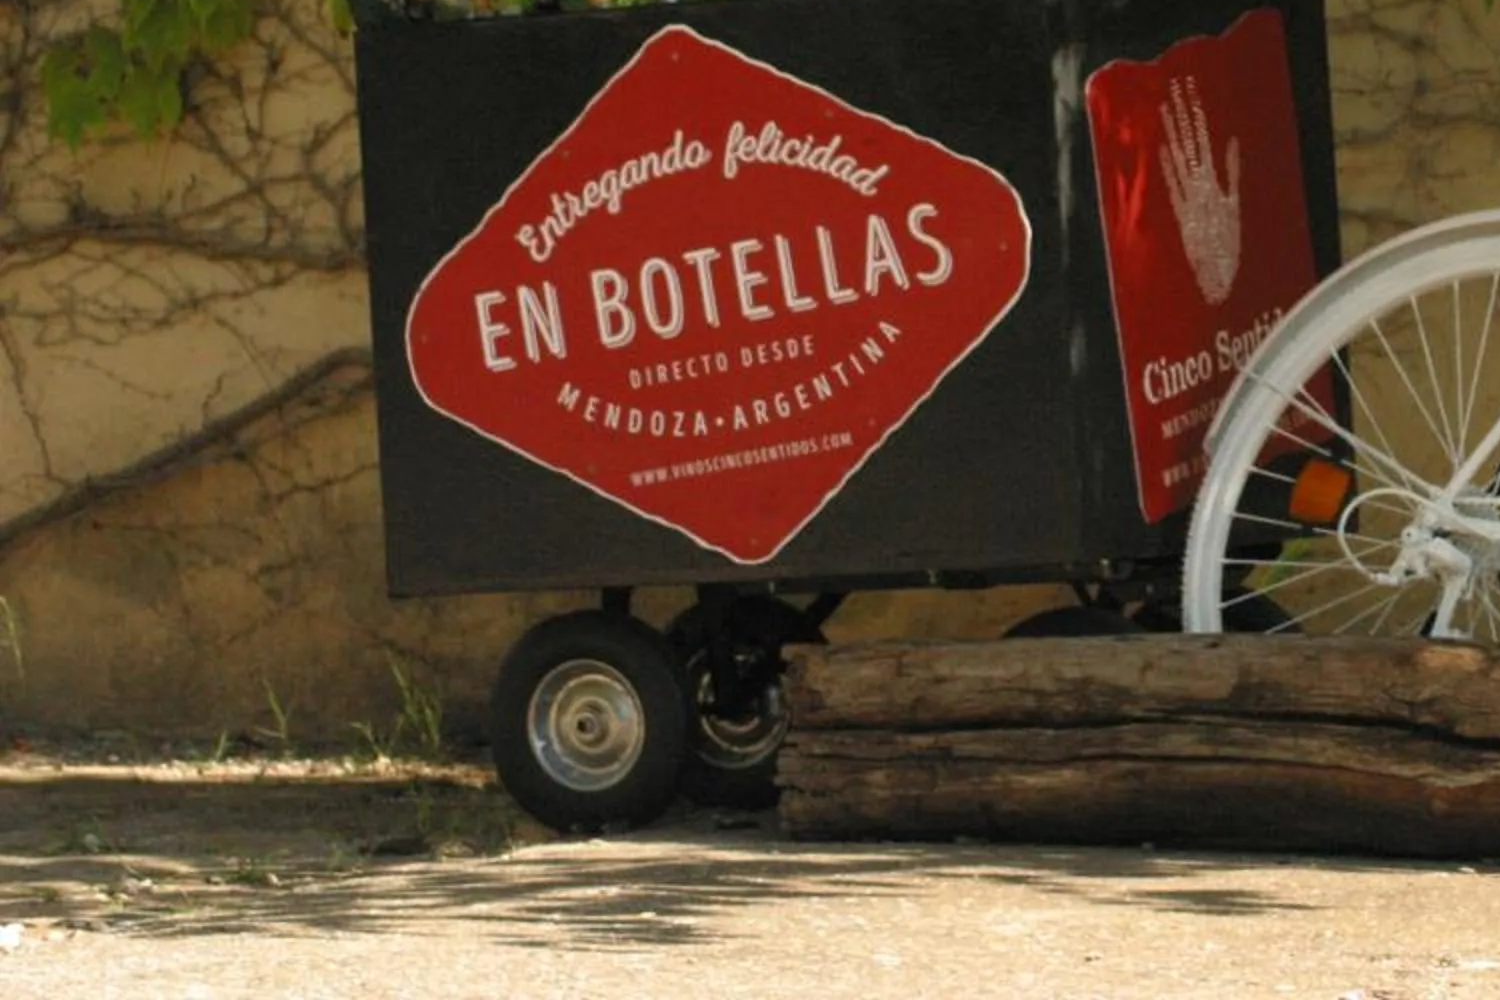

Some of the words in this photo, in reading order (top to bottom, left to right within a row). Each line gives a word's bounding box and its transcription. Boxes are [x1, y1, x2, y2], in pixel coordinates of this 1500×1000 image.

[515, 130, 711, 261] Entregando
[724, 122, 889, 195] felicidad
[474, 281, 567, 371] EN
[592, 204, 953, 349] BOTELLAS
[557, 382, 708, 438] MENDOZA
[734, 321, 901, 430] ARGENTINA
[629, 353, 729, 390] DIRECTO
[742, 335, 816, 368] DESDE
[1143, 350, 1212, 403] Cinco
[1216, 307, 1284, 372] Senti
[630, 432, 853, 487] WWW.VINOSCINCOSENTIDOS.COM
